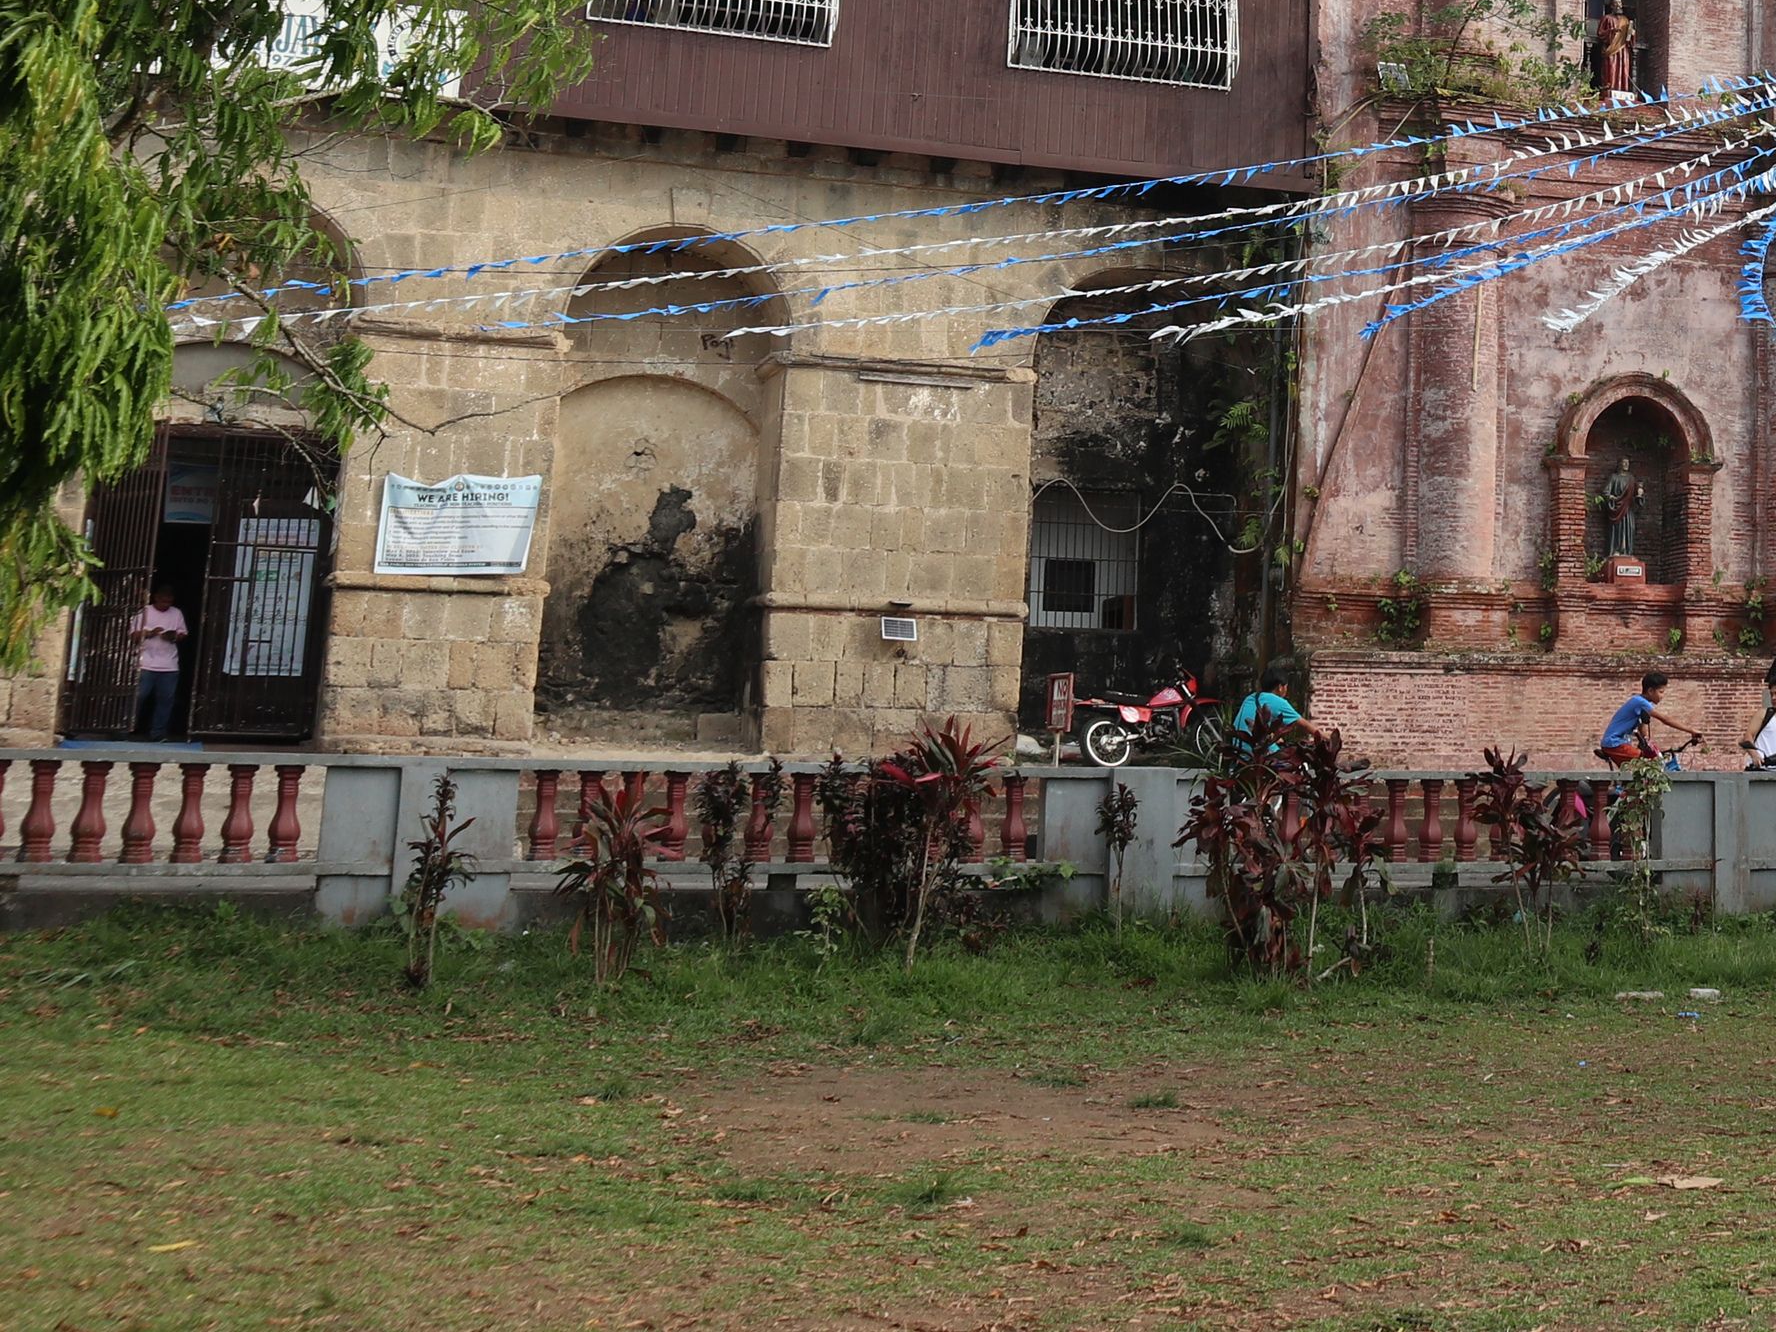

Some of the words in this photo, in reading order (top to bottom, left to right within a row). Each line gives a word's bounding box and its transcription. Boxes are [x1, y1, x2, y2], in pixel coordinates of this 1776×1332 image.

[417, 494, 435, 503] WE
[437, 493, 458, 503] ARE
[462, 492, 509, 502] HIRING!
